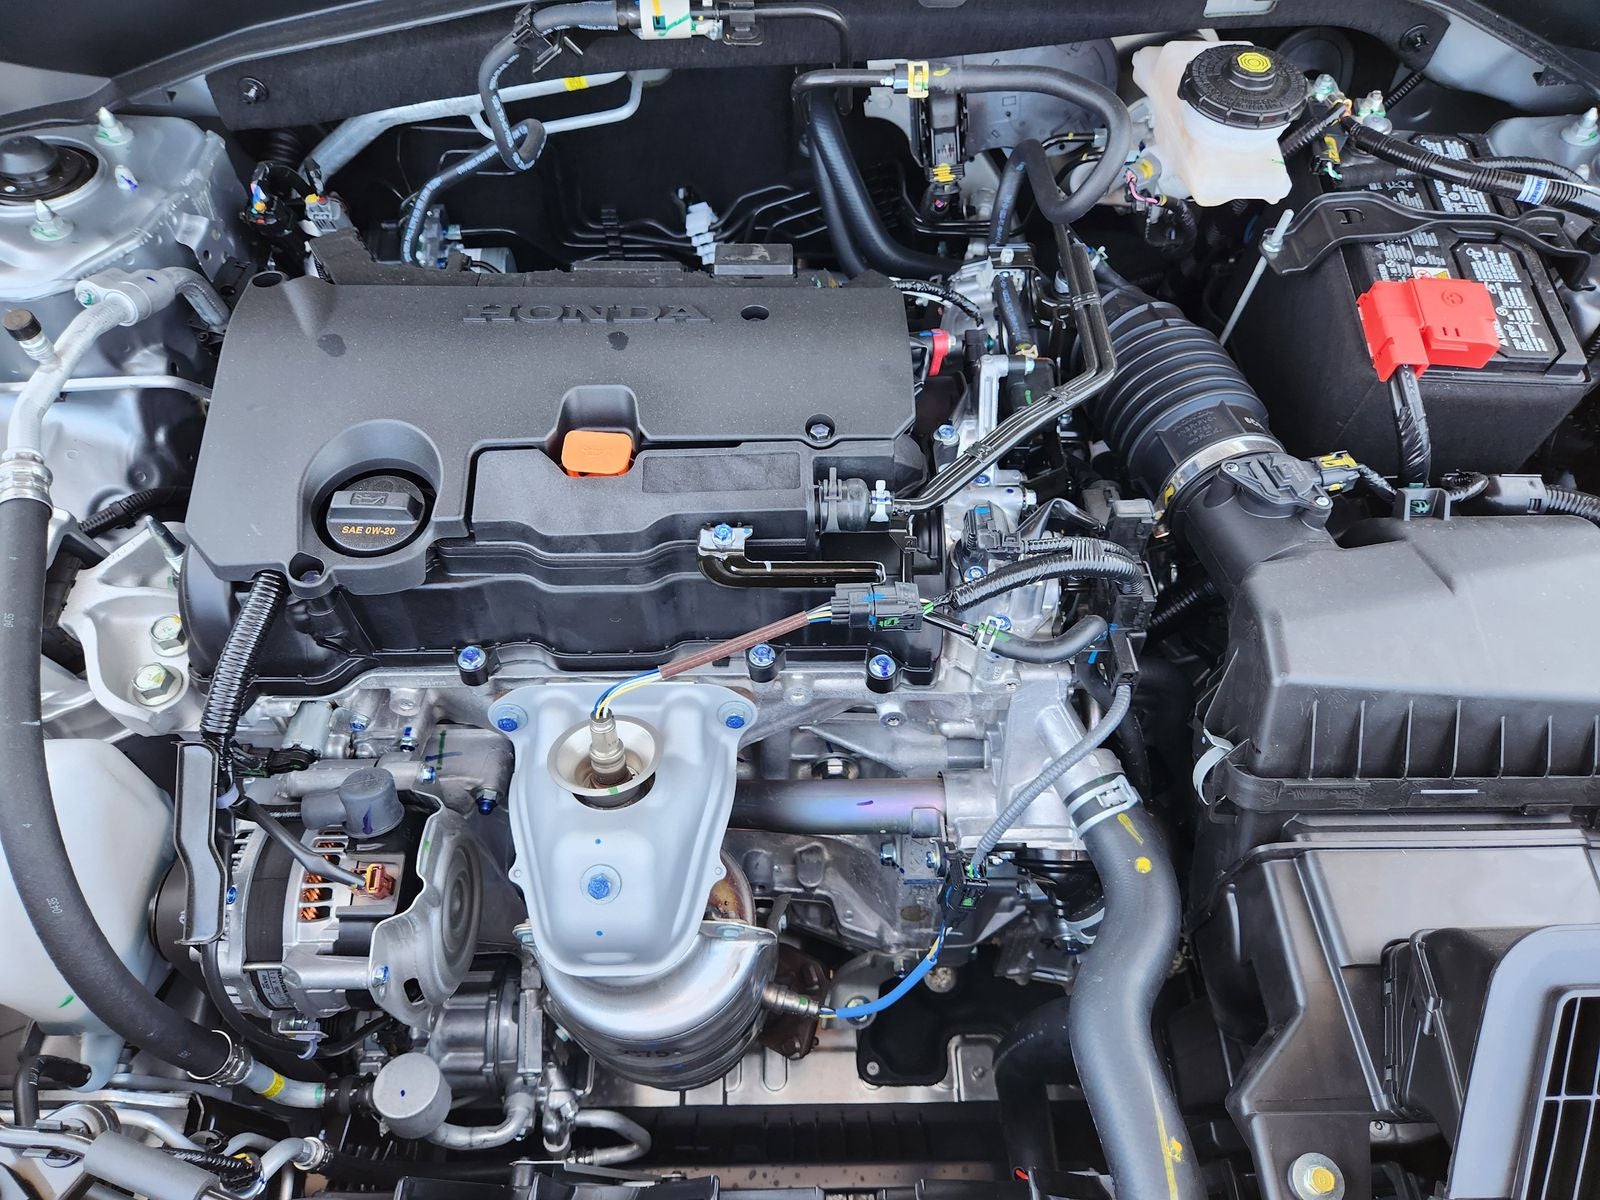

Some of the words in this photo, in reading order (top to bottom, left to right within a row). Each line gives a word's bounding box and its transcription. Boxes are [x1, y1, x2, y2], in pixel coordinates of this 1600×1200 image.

[463, 303, 713, 323] HONDA
[341, 525, 363, 534] SAE
[365, 526, 396, 536] 0W-20
